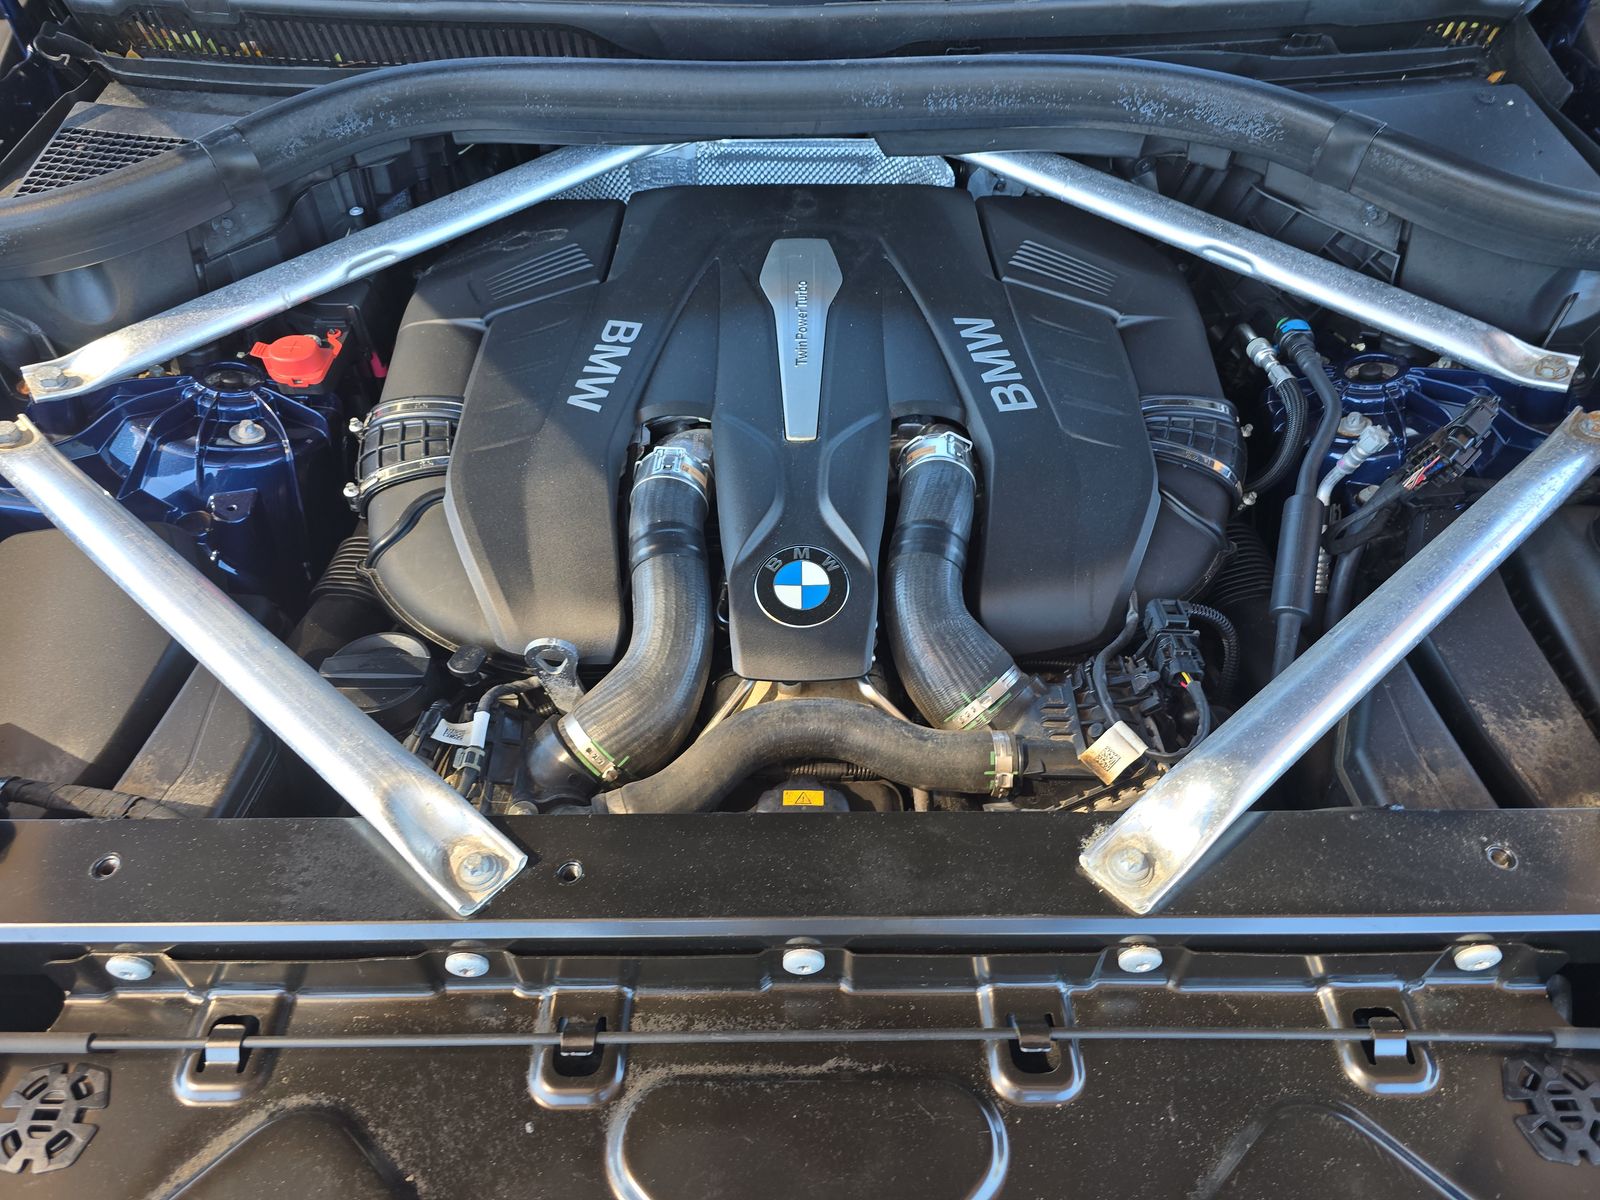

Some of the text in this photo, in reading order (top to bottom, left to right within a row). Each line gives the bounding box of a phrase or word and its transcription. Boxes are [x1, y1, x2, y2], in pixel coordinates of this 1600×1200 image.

[567, 319, 643, 413] BMW
[795, 280, 808, 366] TwinPower Turbo
[952, 317, 1038, 412] BMW
[764, 547, 840, 572] BMW
